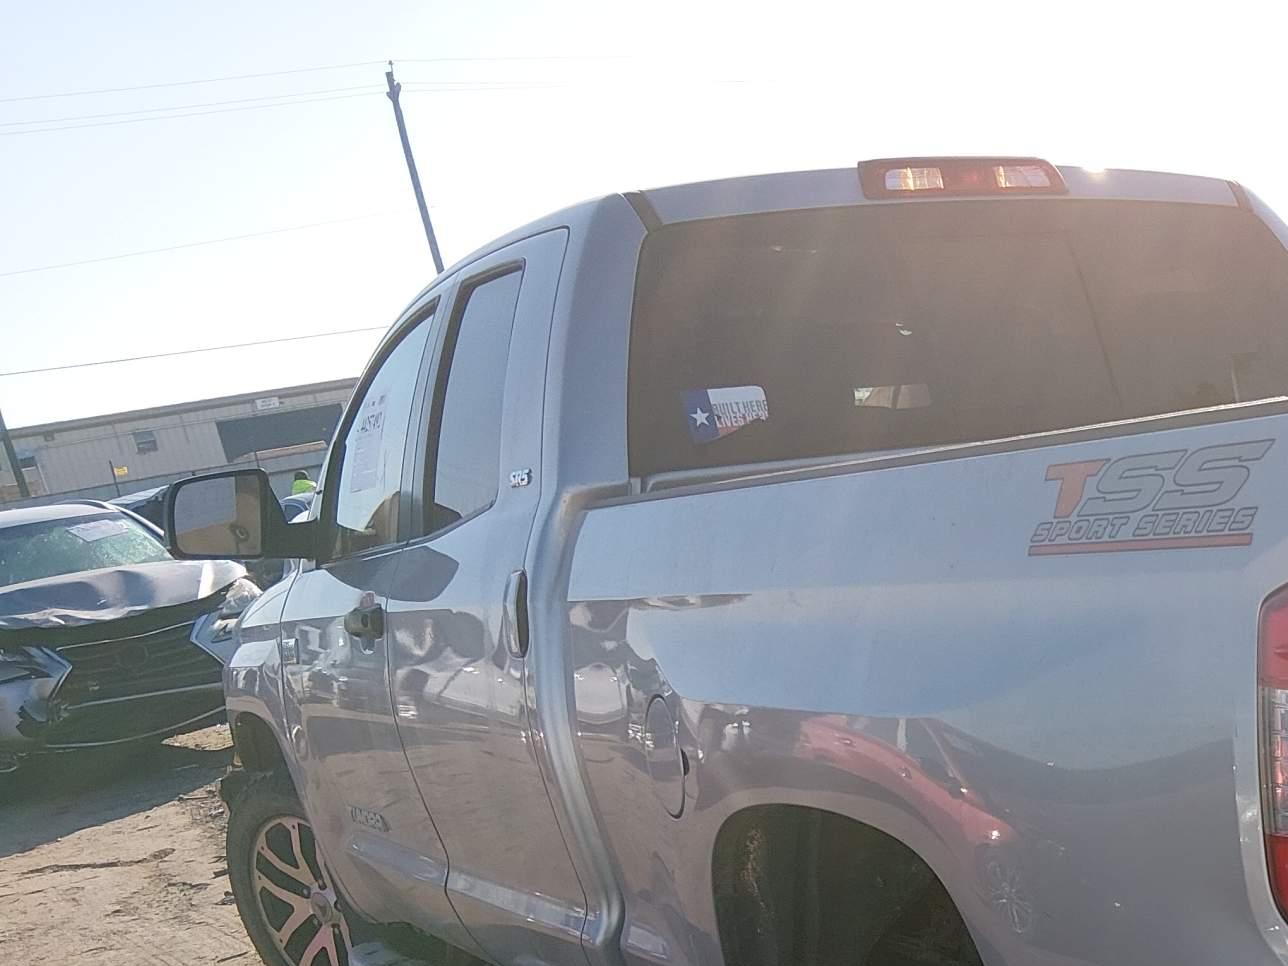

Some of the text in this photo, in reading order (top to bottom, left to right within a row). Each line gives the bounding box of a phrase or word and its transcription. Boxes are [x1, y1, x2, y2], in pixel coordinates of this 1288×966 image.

[714, 413, 745, 428] LIVES
[1044, 438, 1277, 520] TSS
[1030, 505, 1259, 544] SPORT SERIES
